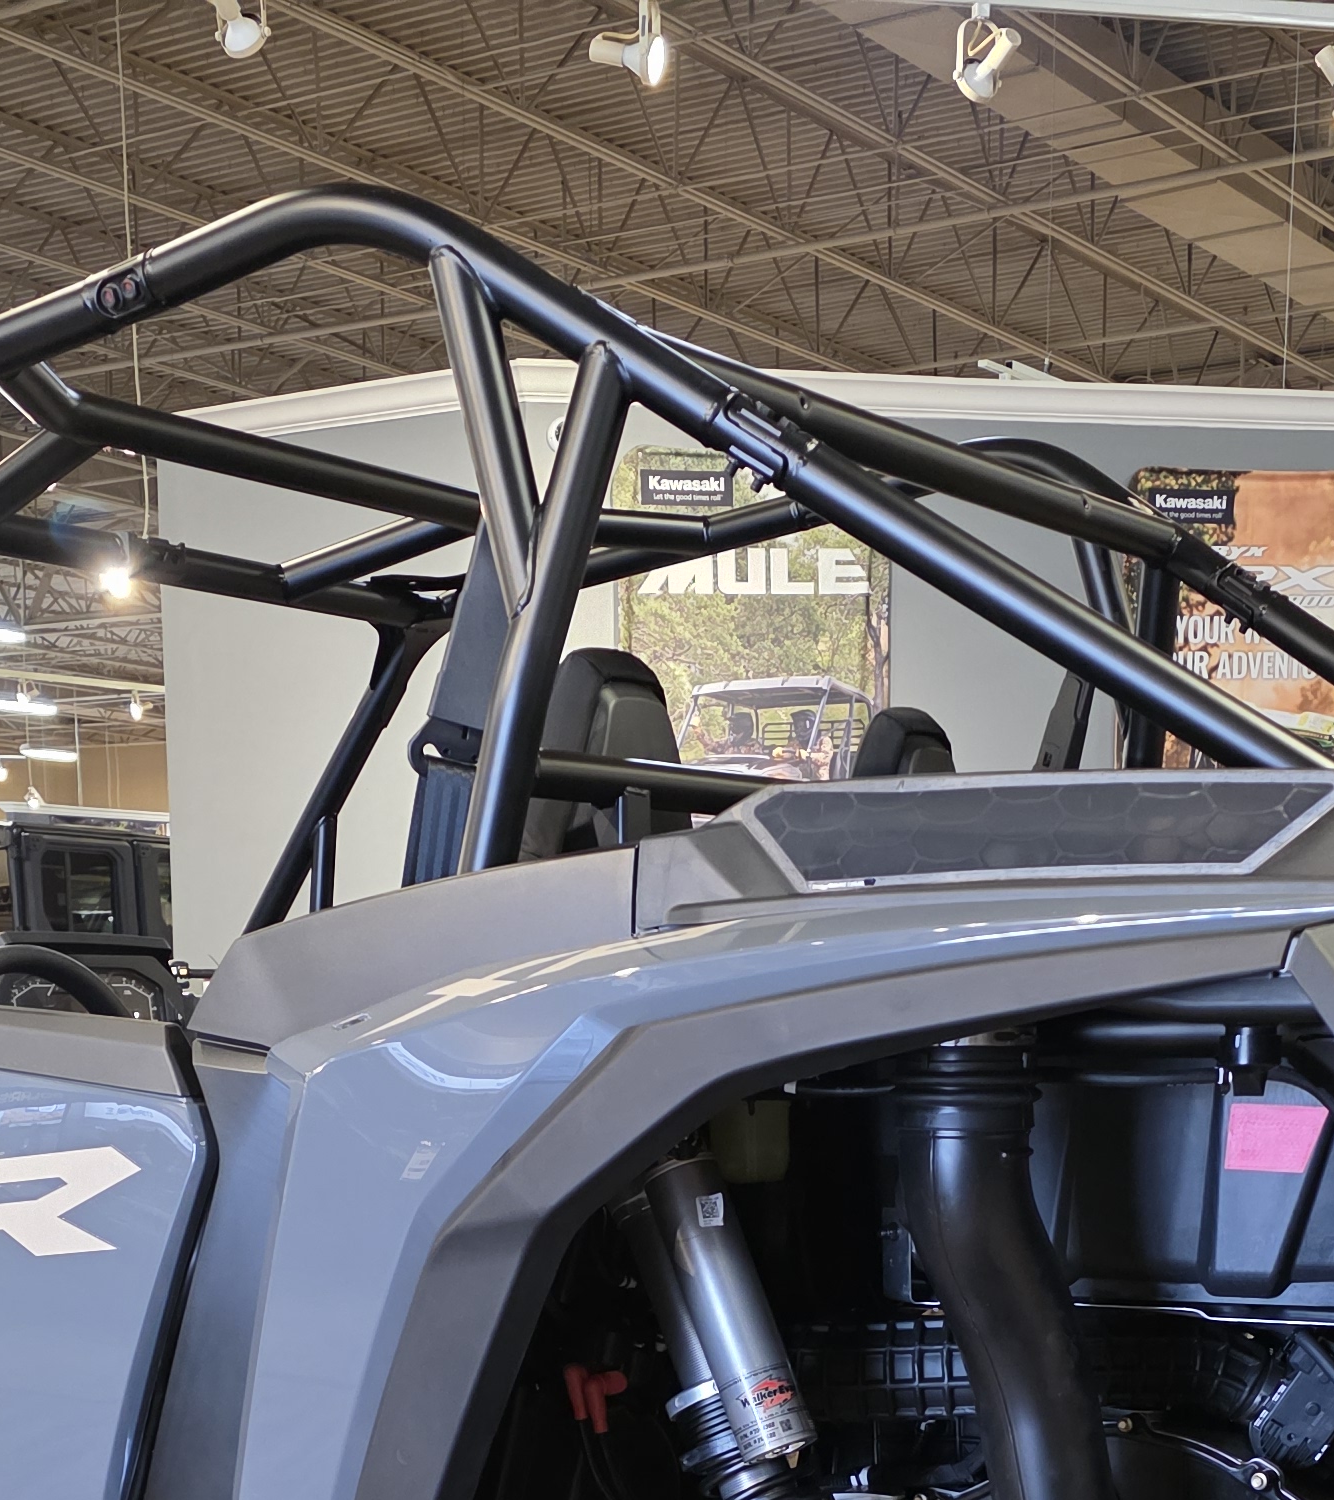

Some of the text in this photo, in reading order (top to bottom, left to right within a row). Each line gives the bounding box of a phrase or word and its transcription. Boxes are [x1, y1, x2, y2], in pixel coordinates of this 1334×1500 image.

[648, 475, 725, 492] Kawasaki
[676, 494, 692, 502] good
[1155, 494, 1227, 509] Kawasaki
[1180, 512, 1195, 520] good
[637, 547, 870, 595] MULE
[1176, 615, 1235, 644] YOUR
